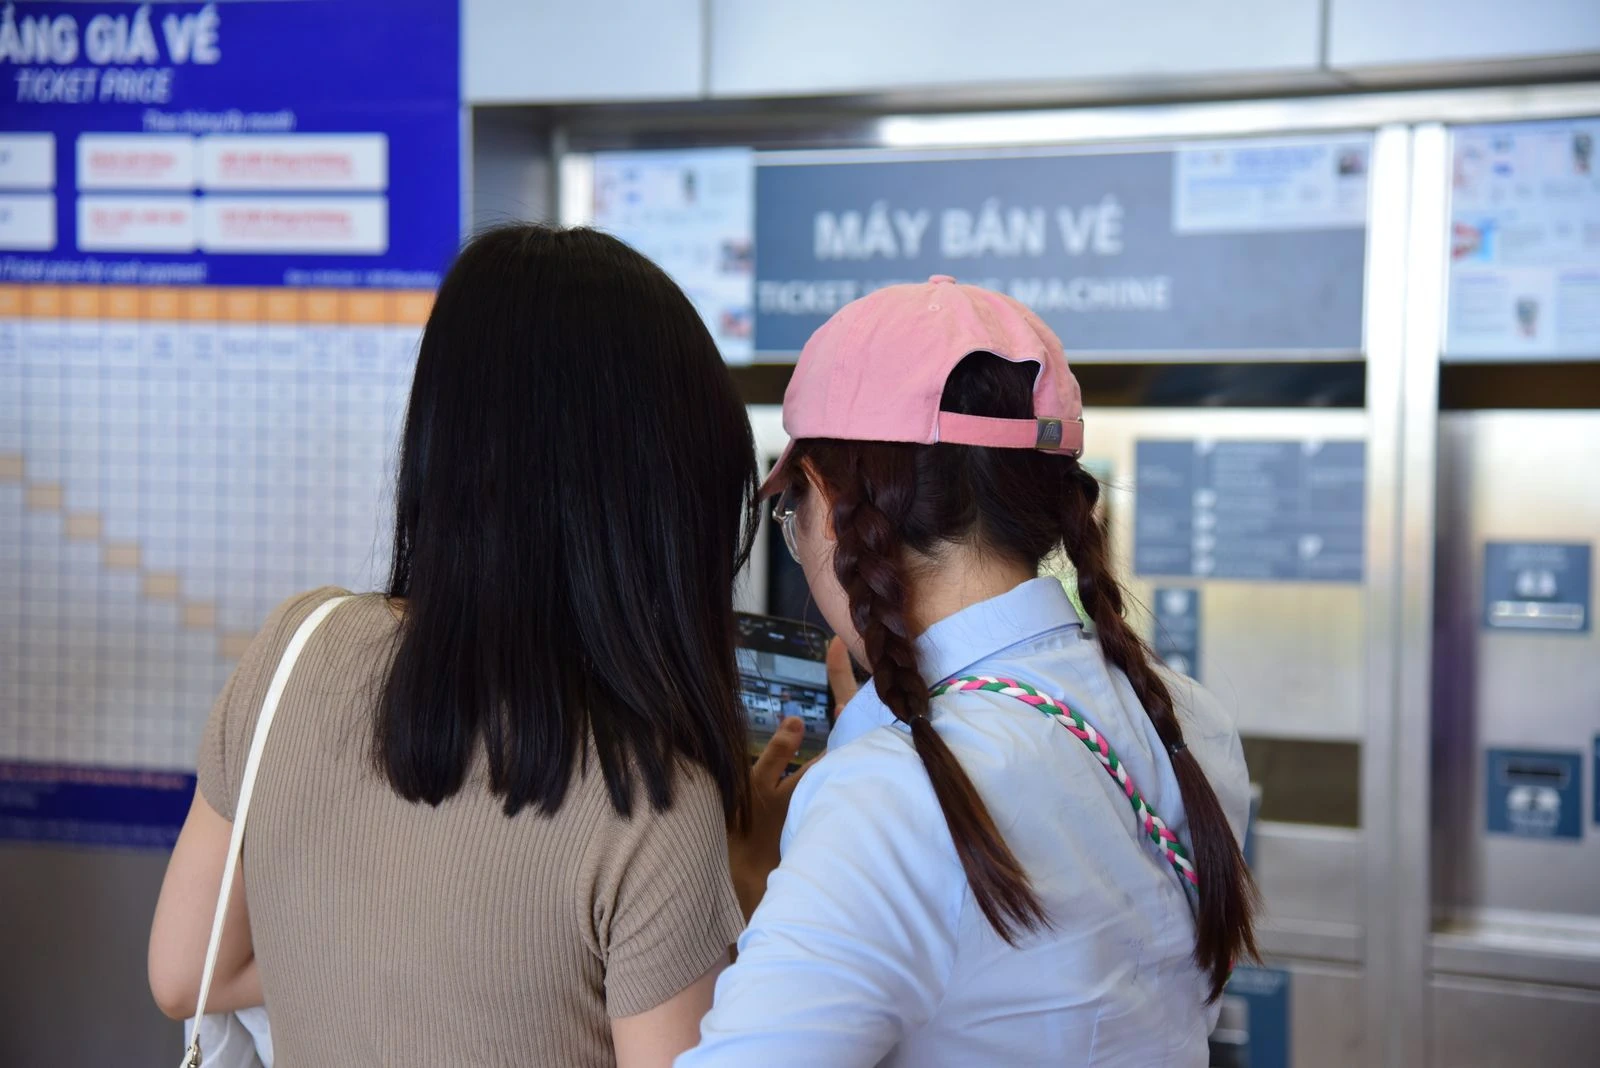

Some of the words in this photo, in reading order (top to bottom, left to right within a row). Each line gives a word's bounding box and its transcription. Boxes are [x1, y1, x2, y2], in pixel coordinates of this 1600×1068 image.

[84, 3, 160, 65] GIÁ
[161, 1, 222, 65] VÉ
[15, 67, 98, 104] TICKET
[99, 67, 173, 104] PRICE
[814, 200, 931, 260] MÁY
[942, 197, 1046, 257] BÁN
[1056, 196, 1124, 255] VÉ
[758, 281, 858, 314] TICKET
[1009, 277, 1170, 310] MACHINE
